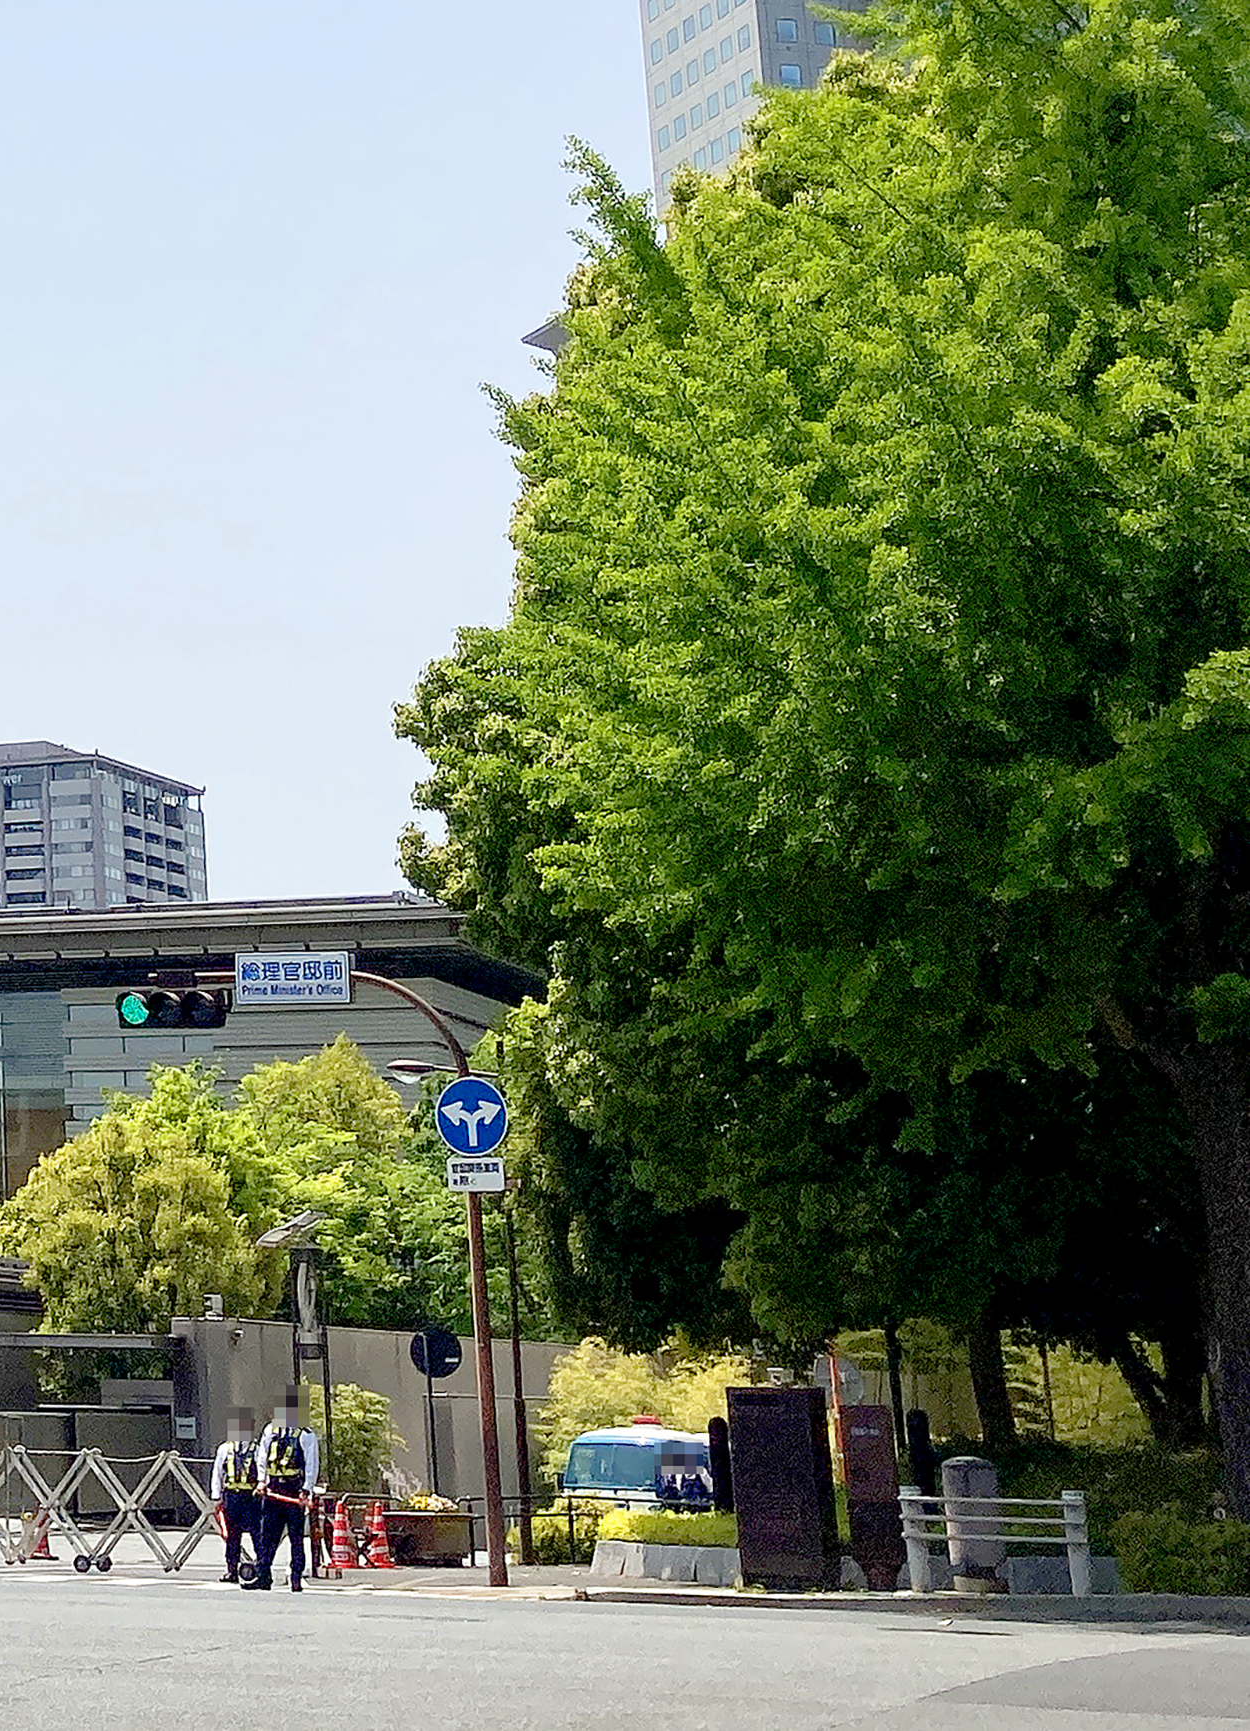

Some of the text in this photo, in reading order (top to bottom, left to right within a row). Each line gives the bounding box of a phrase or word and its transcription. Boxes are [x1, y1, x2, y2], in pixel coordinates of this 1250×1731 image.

[241, 960, 343, 981] 総理官邸前
[241, 983, 343, 996] Prime Minister's Office
